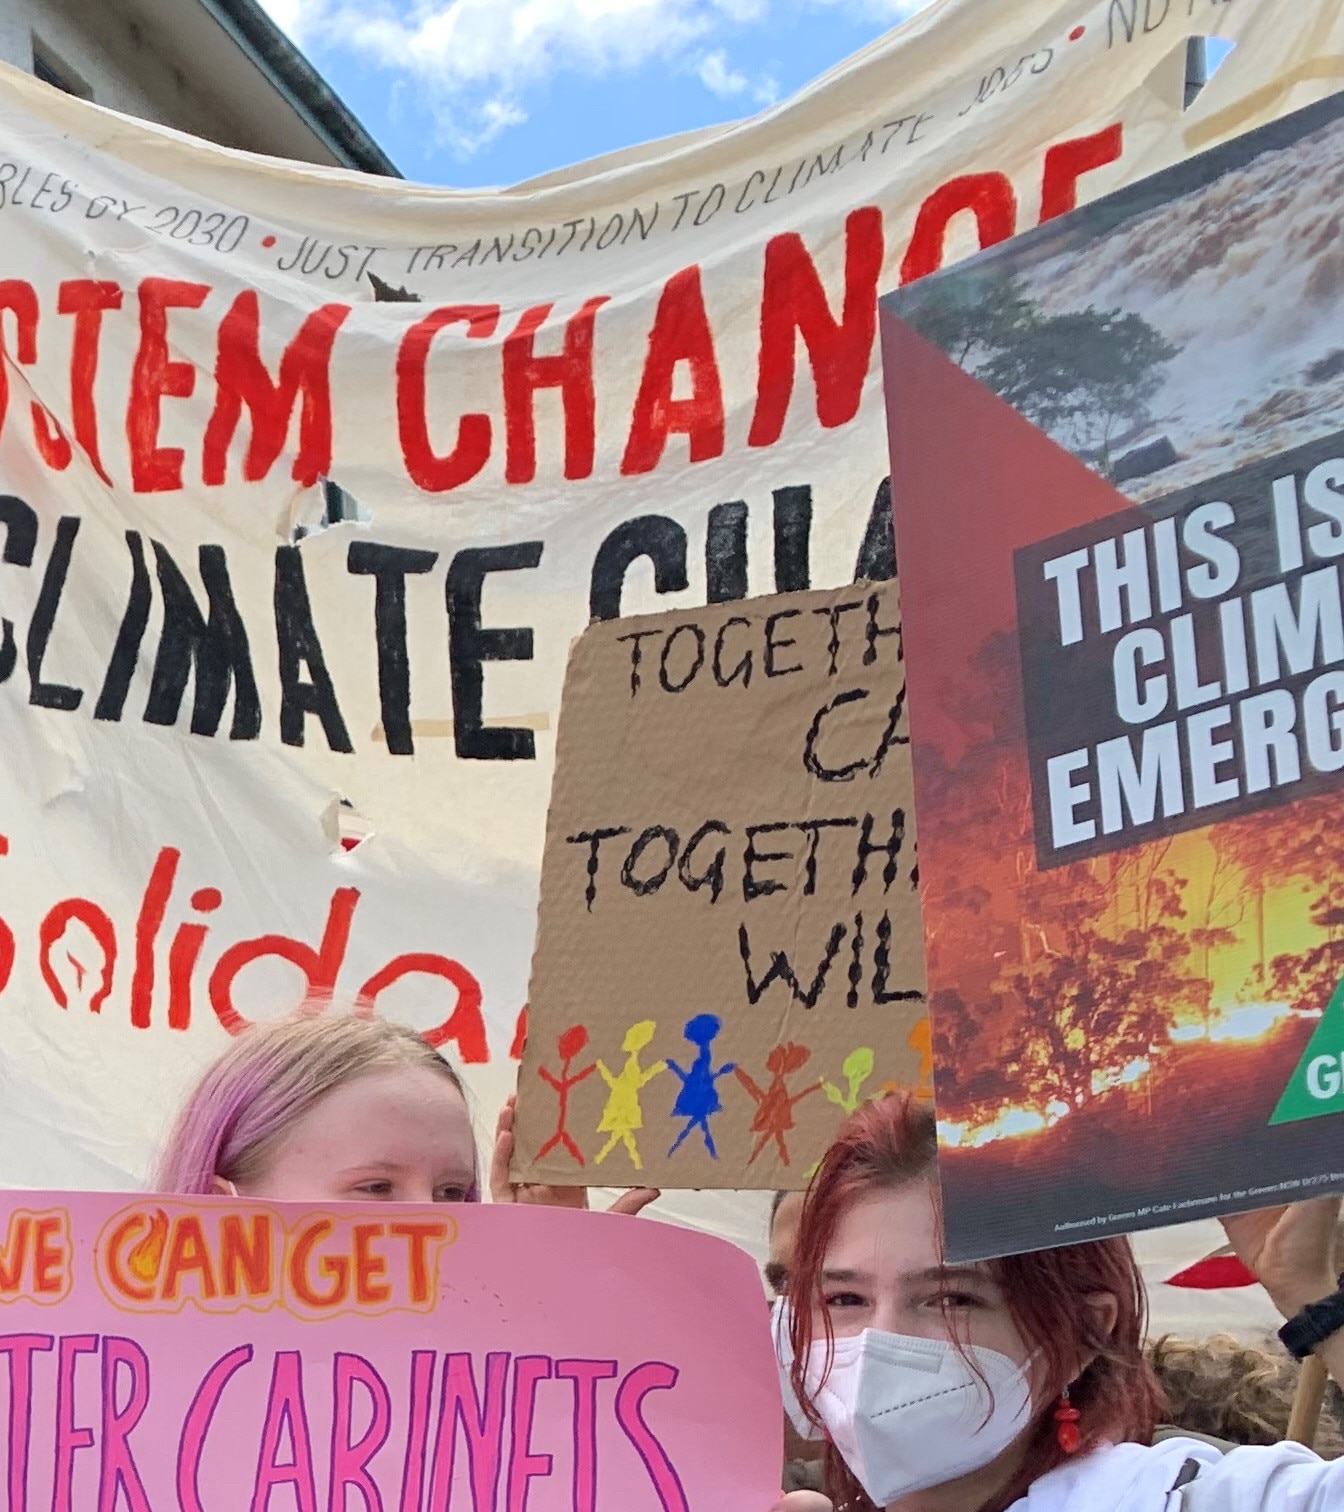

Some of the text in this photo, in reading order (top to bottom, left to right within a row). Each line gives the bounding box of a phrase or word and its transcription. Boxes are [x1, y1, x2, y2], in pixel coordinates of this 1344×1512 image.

[144, 206, 250, 253] 2030
[277, 236, 387, 283] JUST
[406, 201, 661, 275] TRANSITION
[671, 184, 727, 232] TO
[735, 112, 935, 213] CLIMATE
[1043, 457, 1344, 647] THIS IS
[1047, 669, 1344, 849] EMERG
[566, 807, 919, 913] TOGETH
[103, 1208, 275, 1305] CAN
[286, 1216, 452, 1311] GET
